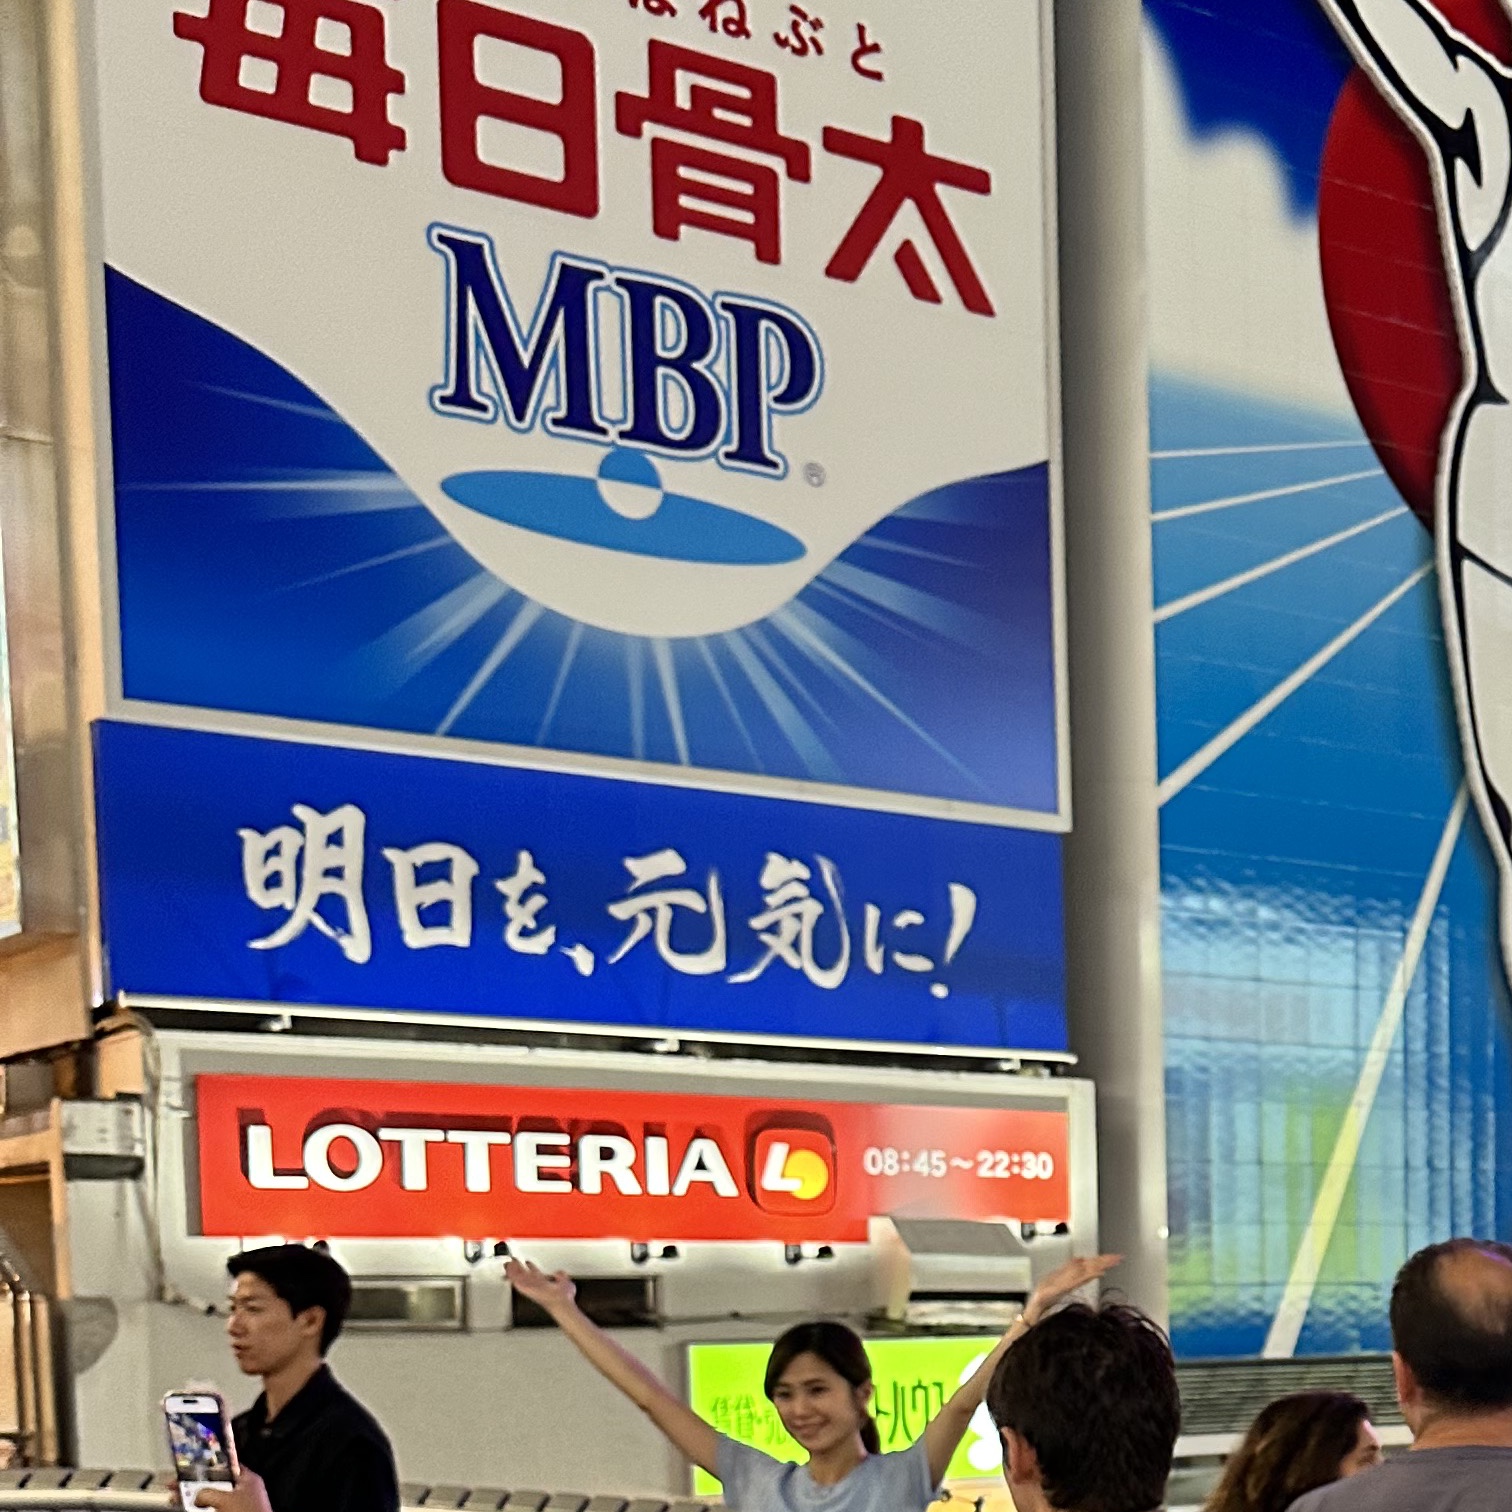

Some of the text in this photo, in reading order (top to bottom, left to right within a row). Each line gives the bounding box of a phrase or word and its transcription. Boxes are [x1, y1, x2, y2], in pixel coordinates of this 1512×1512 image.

[628, 0, 884, 82] ねぶと
[172, 0, 996, 318] 毎日骨太
[427, 223, 824, 479] MBP
[246, 1122, 740, 1198] LOTTERIA
